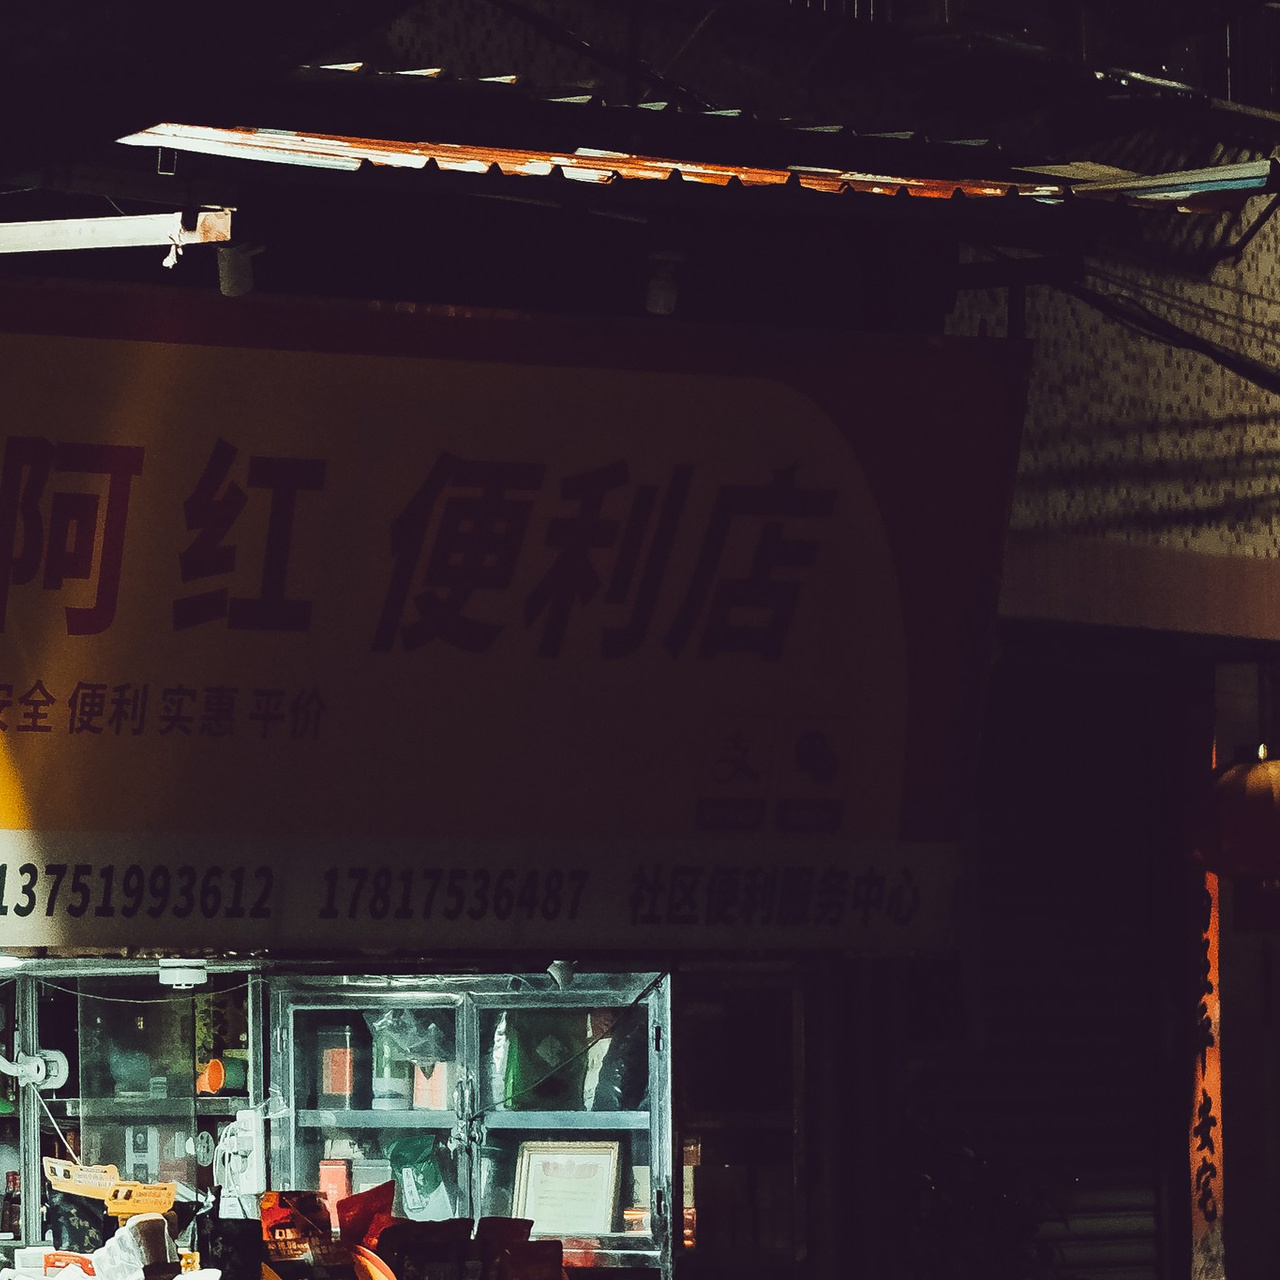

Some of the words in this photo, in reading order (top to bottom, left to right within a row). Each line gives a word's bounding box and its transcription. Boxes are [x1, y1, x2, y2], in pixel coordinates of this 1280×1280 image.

[67, 681, 150, 737] 便利
[158, 684, 240, 738] 实惠
[319, 867, 590, 921] 17817536487
[629, 864, 922, 926] 社区便利服务中心
